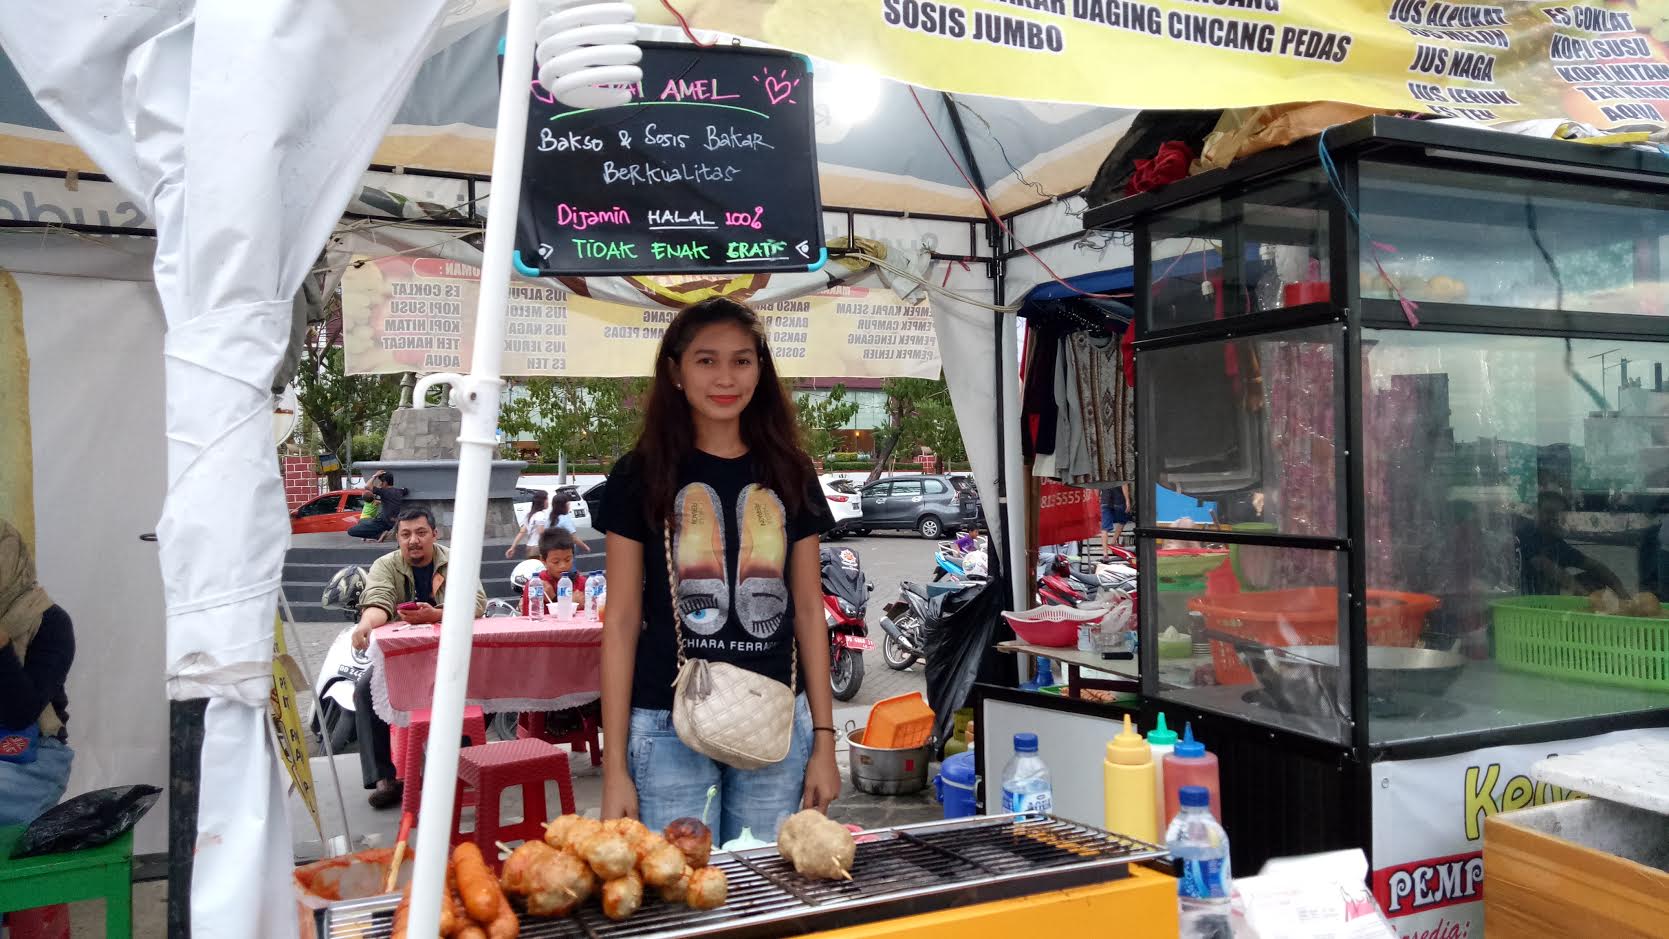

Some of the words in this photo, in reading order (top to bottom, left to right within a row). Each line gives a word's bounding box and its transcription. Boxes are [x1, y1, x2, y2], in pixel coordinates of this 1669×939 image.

[884, 0, 966, 38] SOSIS
[973, 11, 1062, 52] JUMBO
[1389, 0, 1426, 24] JUS
[1427, 3, 1508, 27] ALPUKAT
[1543, 8, 1572, 26] ES
[1572, 6, 1634, 31] COKLAT
[1073, 0, 1161, 35] DAGING
[1168, 11, 1275, 54] CINCANG
[1279, 26, 1352, 63] PEDAS
[1551, 34, 1595, 59] KOPI
[1592, 38, 1651, 58] SUSU
[1410, 45, 1449, 75] JUS
[1448, 49, 1495, 81] NAGA
[1556, 65, 1613, 82] KOPI
[661, 78, 741, 101] AMEL
[1408, 83, 1448, 102] JUS
[1447, 88, 1519, 104] JERUK
[1576, 87, 1622, 101] TEH
[1600, 104, 1664, 121] AQUA
[538, 131, 602, 152] Bakso
[618, 131, 632, 149] &
[556, 204, 631, 230] Dijamin
[648, 209, 716, 226] HALAL
[725, 206, 763, 229] 100%
[572, 239, 638, 260] TIDAK
[651, 241, 711, 260] ENAK
[1388, 857, 1485, 913] PEMP
